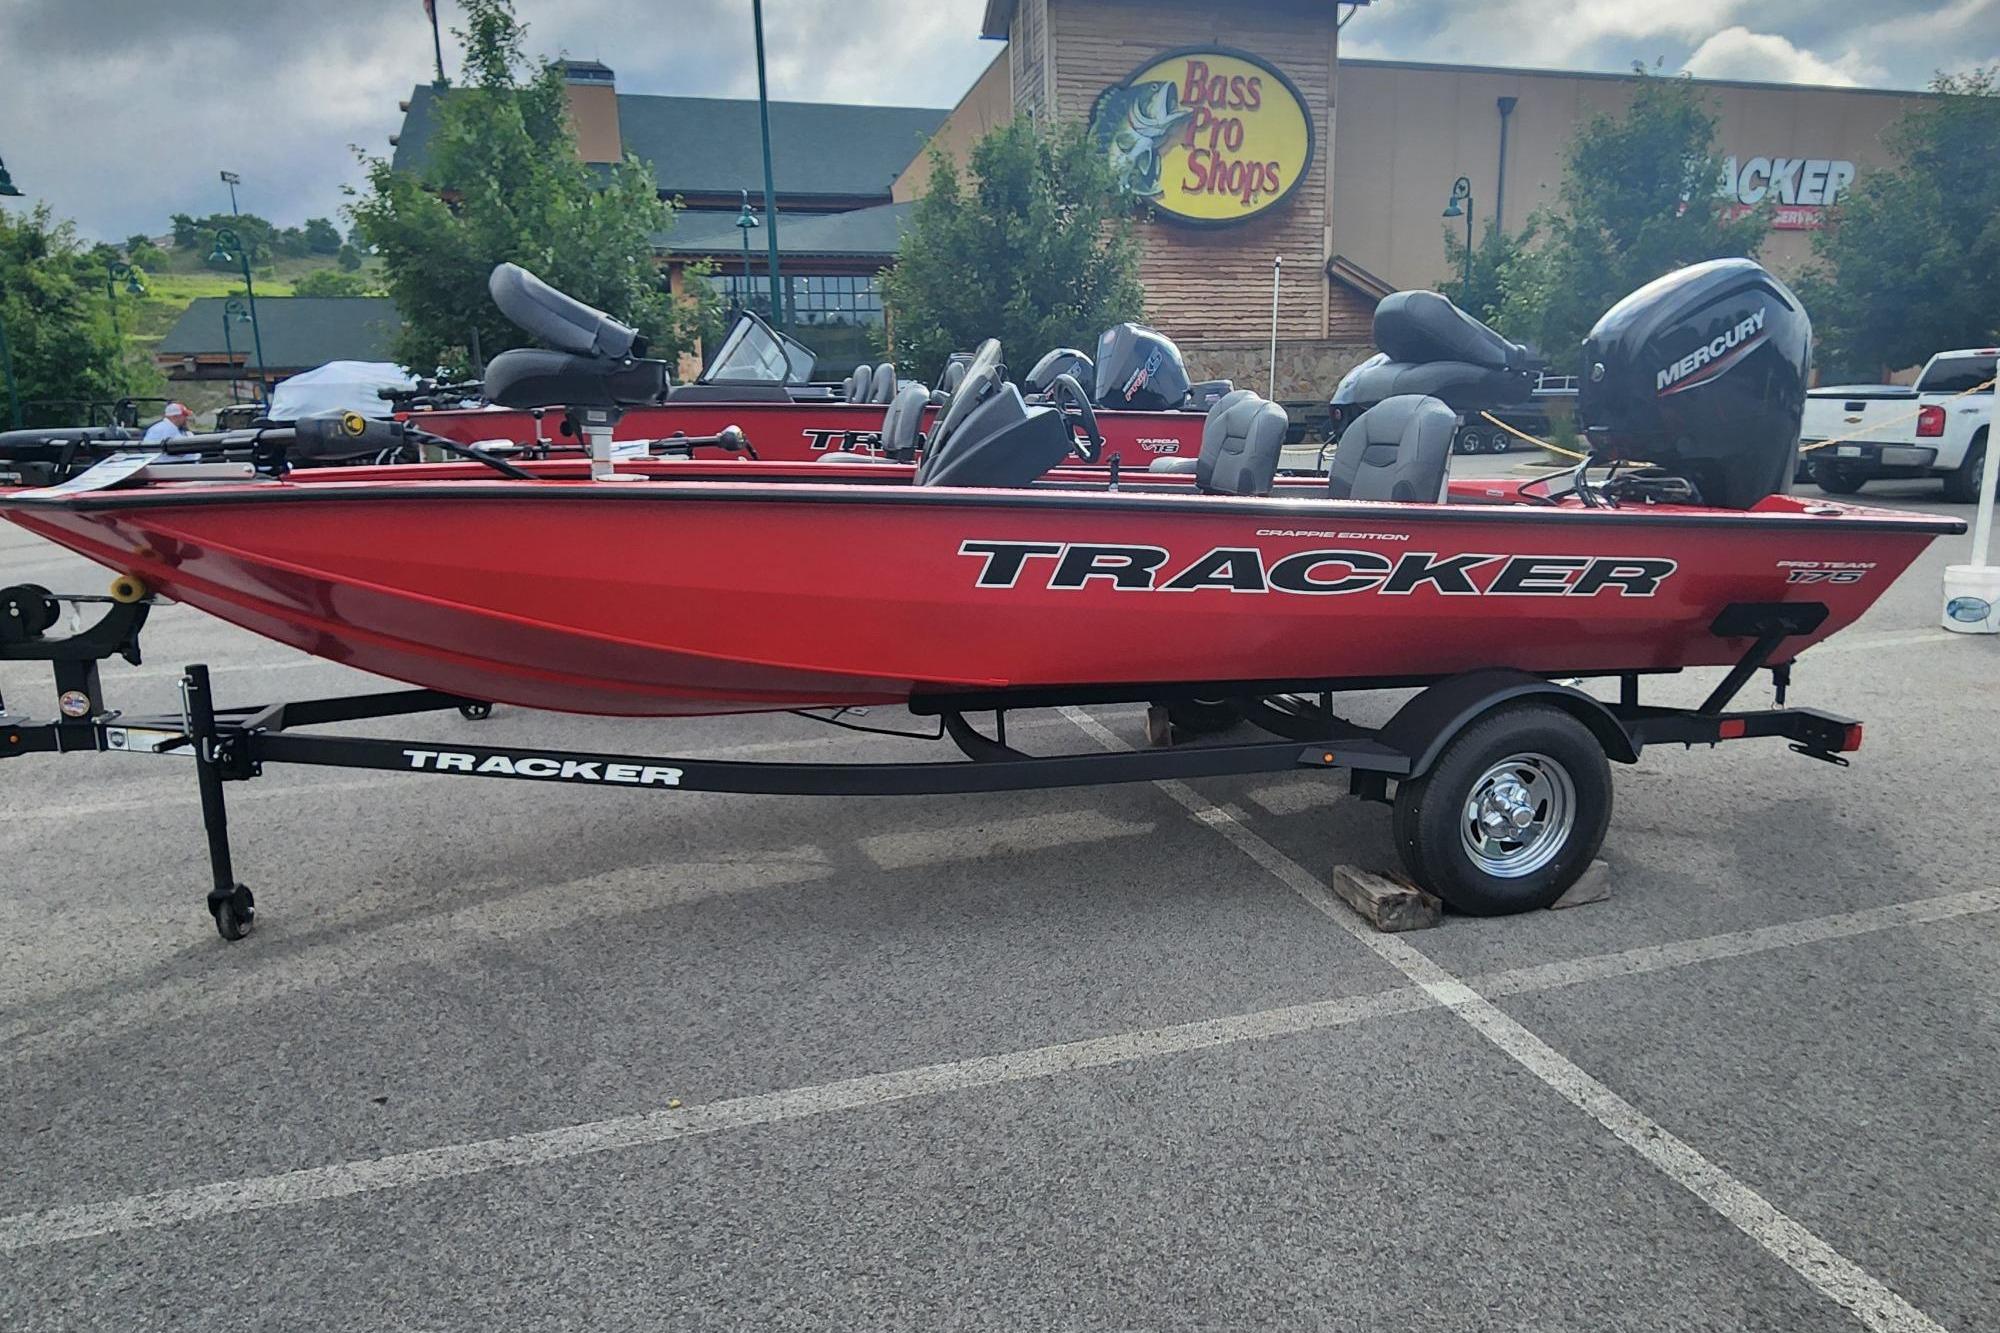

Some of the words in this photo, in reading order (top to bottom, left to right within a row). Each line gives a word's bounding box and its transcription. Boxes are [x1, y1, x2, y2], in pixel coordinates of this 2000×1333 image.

[1180, 60, 1263, 112] Bass
[1181, 106, 1245, 151] Pro
[1182, 148, 1281, 207] Shops
[1657, 307, 1766, 390] MERCURY
[1141, 443, 1180, 454] V18
[1256, 529, 1335, 539] CRAPPIE
[1337, 532, 1410, 541] EDITION
[957, 539, 1678, 597] TRACKER
[1776, 561, 1820, 569] PRO
[1786, 569, 1867, 584] 175
[402, 750, 684, 786] TRACKER
